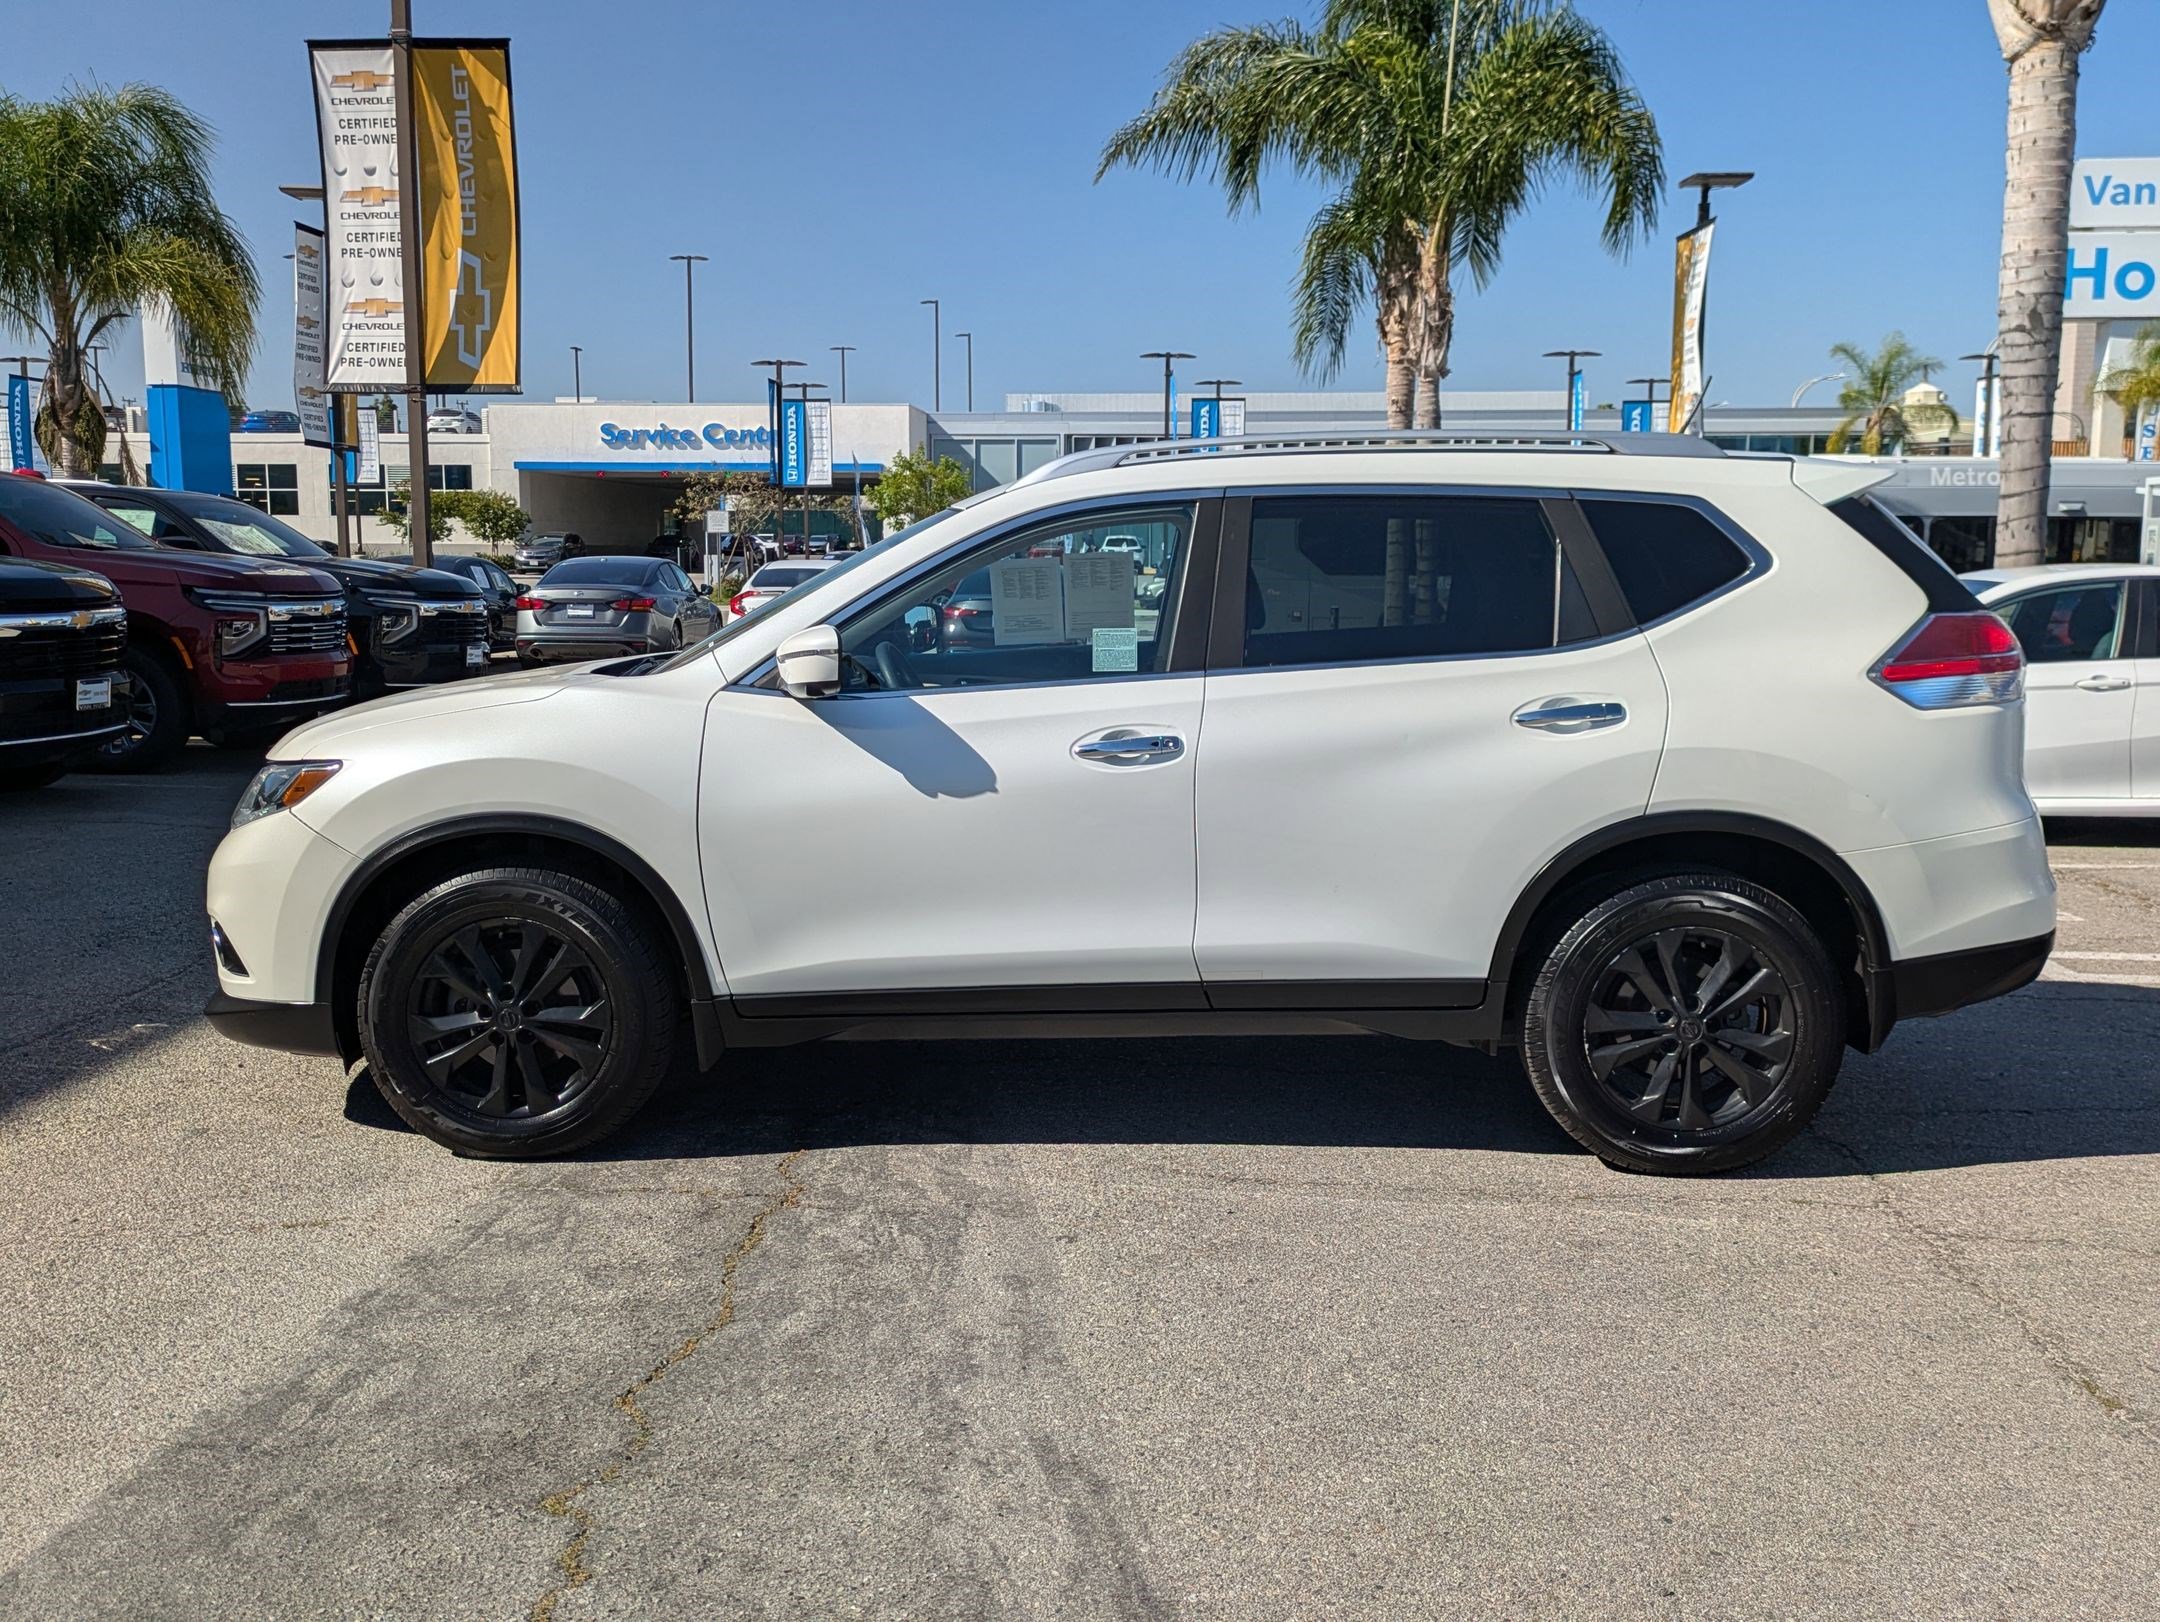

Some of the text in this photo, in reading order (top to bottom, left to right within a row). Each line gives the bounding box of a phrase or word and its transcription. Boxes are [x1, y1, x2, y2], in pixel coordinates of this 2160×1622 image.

[331, 97, 396, 106] CHEVROLE
[338, 118, 397, 129] CERTIFIED
[334, 134, 397, 145] PRE-OWNE
[452, 63, 477, 236] CHEVROLET
[2083, 175, 2156, 206] Van
[340, 212, 400, 220] CHEVROLE
[341, 248, 402, 258] PRE-OWNE
[347, 343, 406, 352] CERTIFIED
[340, 357, 406, 367] PRE-OWNE
[14, 383, 24, 456] HONDA
[600, 422, 778, 445] Service Cent
[787, 404, 798, 467] HONDA
[1930, 467, 2000, 487] Metro
